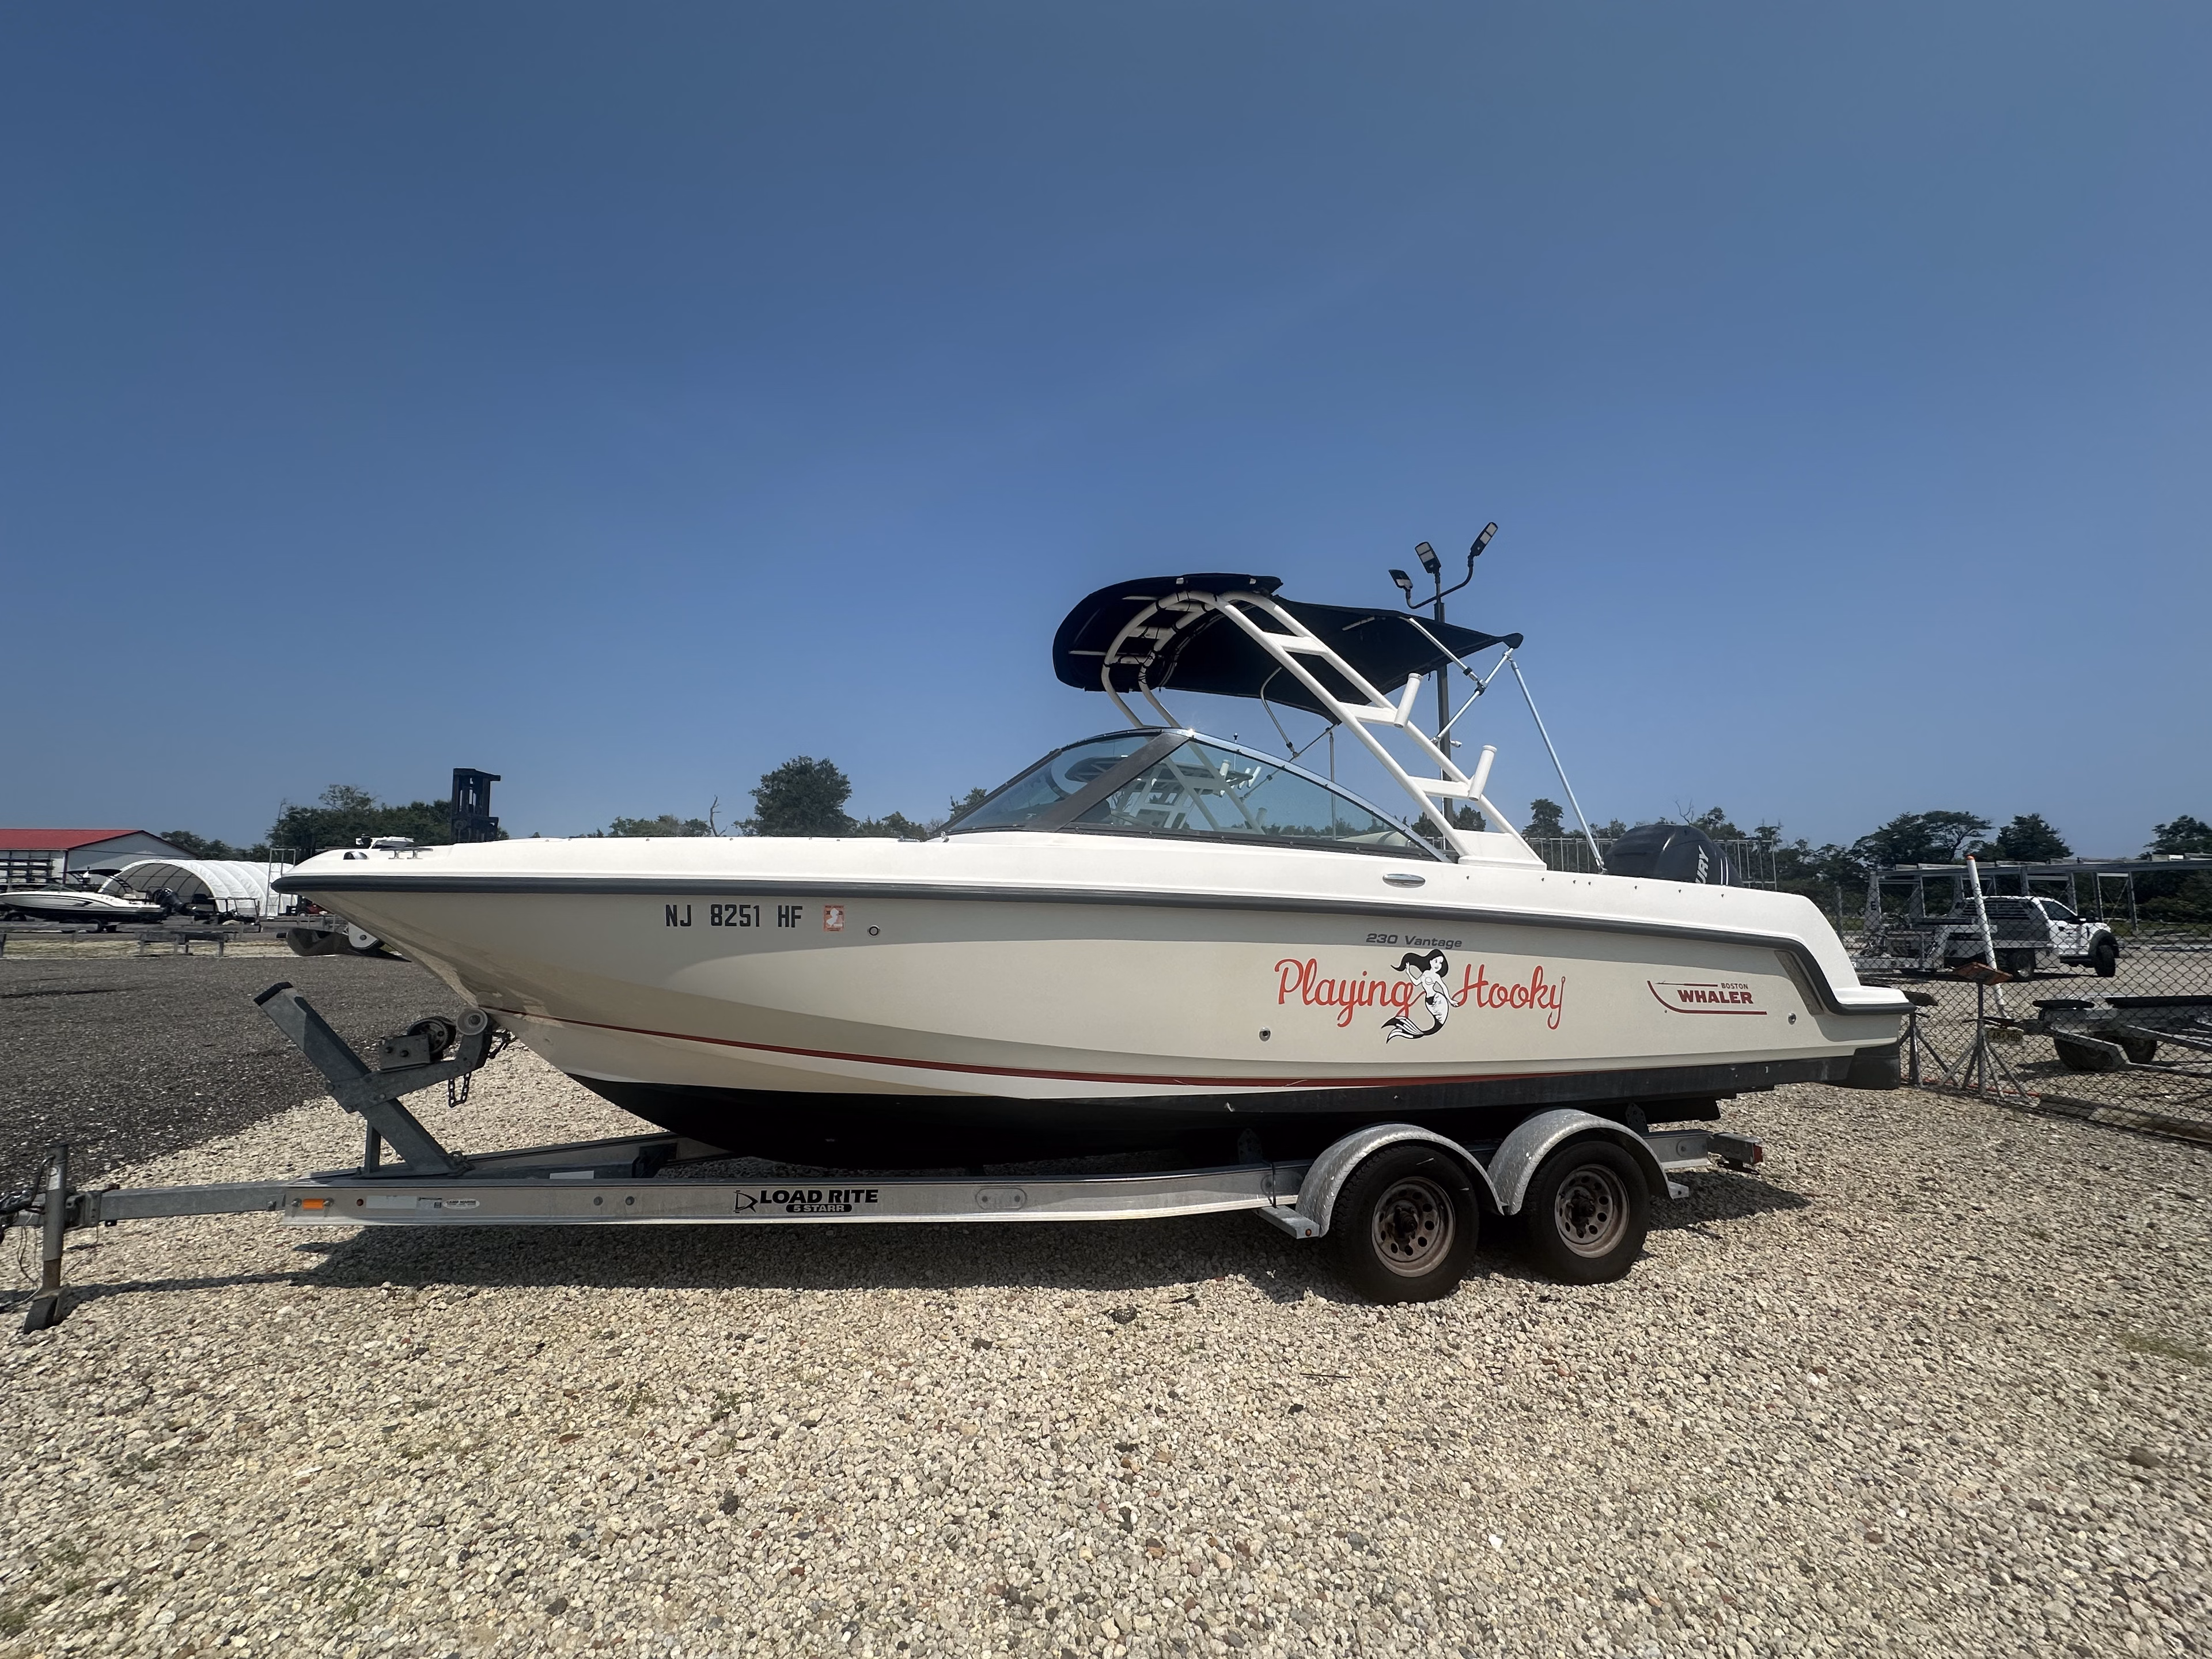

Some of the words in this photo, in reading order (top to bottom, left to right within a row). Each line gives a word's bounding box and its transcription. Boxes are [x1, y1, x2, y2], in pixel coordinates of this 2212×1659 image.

[665, 904, 692, 927] NJ
[710, 904, 760, 927] 8251
[778, 904, 803, 928] HF
[1366, 933, 1398, 944] 230
[1404, 935, 1463, 949] Vantage
[1274, 958, 1425, 1028] Playing
[1451, 964, 1566, 1030] Hooky
[1677, 989, 1754, 1004] WHALER
[760, 1190, 823, 1204] LOAD
[828, 1189, 879, 1203] RITE
